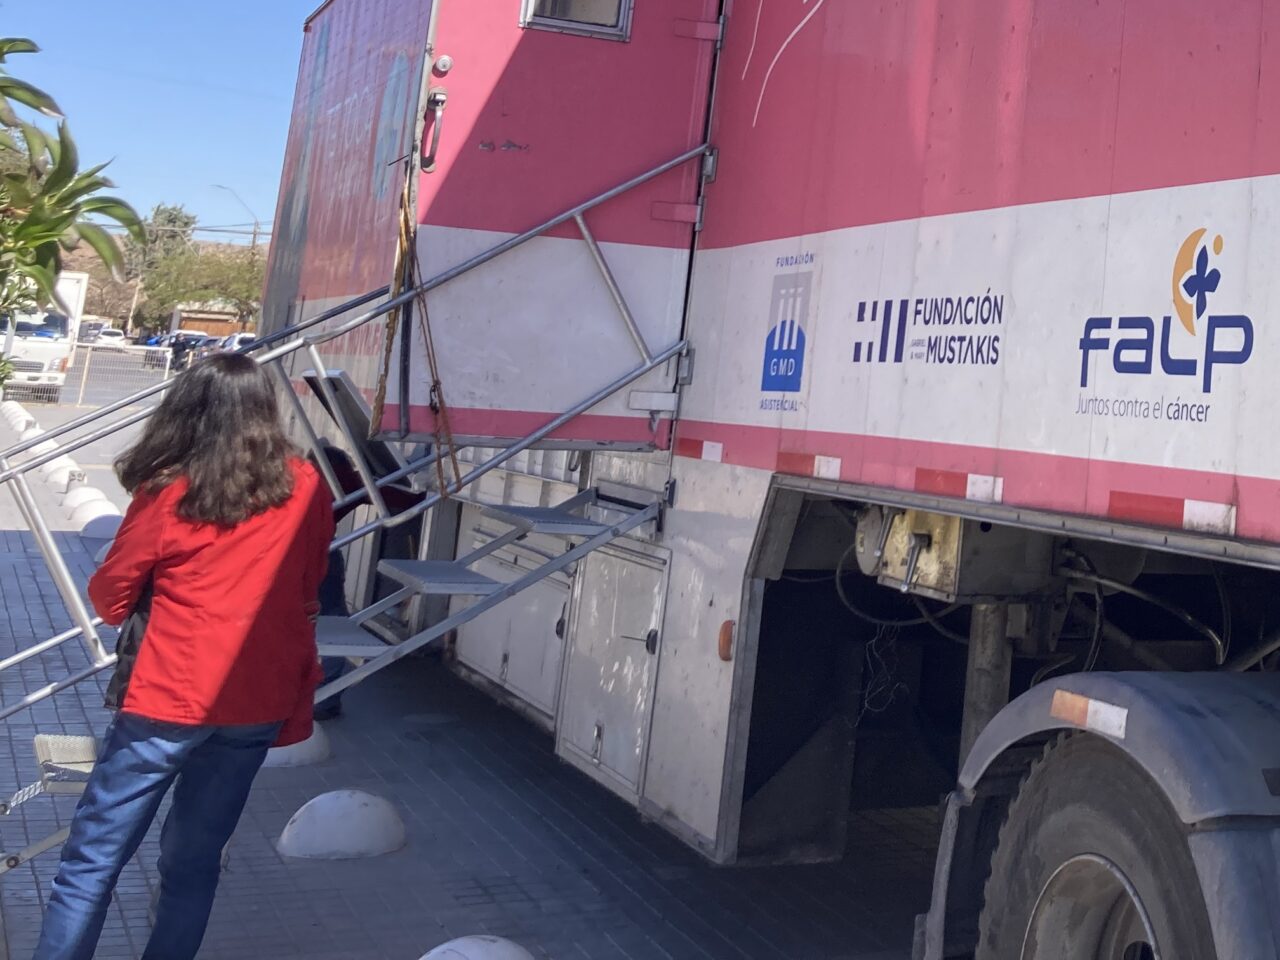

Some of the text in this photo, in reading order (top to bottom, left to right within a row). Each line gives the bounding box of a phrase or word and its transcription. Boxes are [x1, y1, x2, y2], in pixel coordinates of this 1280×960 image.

[913, 287, 1004, 326] FUNDACIÓN
[926, 335, 1000, 365] MUSTAKIS
[770, 358, 796, 377] GMD
[1076, 393, 1211, 423] Juntos contra el cáncer
